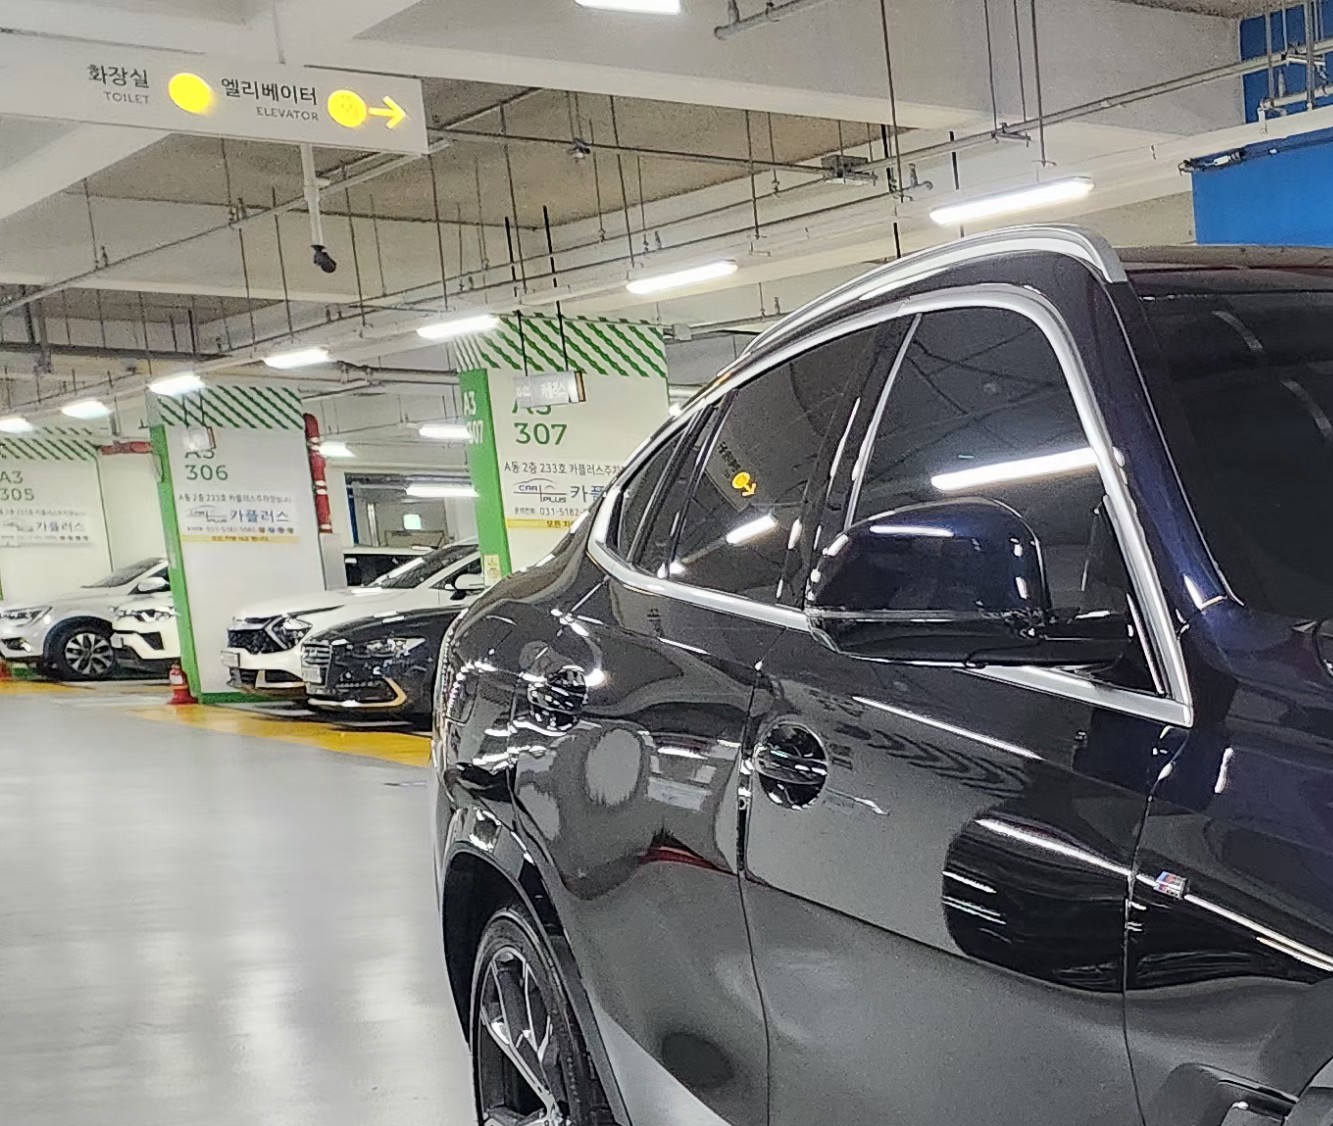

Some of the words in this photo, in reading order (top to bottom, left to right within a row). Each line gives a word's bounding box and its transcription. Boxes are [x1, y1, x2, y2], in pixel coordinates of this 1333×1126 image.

[88, 64, 150, 89] 화장실
[103, 91, 150, 105] TOILET
[220, 77, 318, 106] 엘리베이터
[256, 106, 319, 122] ELEVATOR
[514, 422, 568, 446] 307
[185, 464, 229, 481] 306
[540, 462, 568, 475] 233호
[0, 488, 35, 501] 305
[540, 507, 588, 516] 031-5182-
